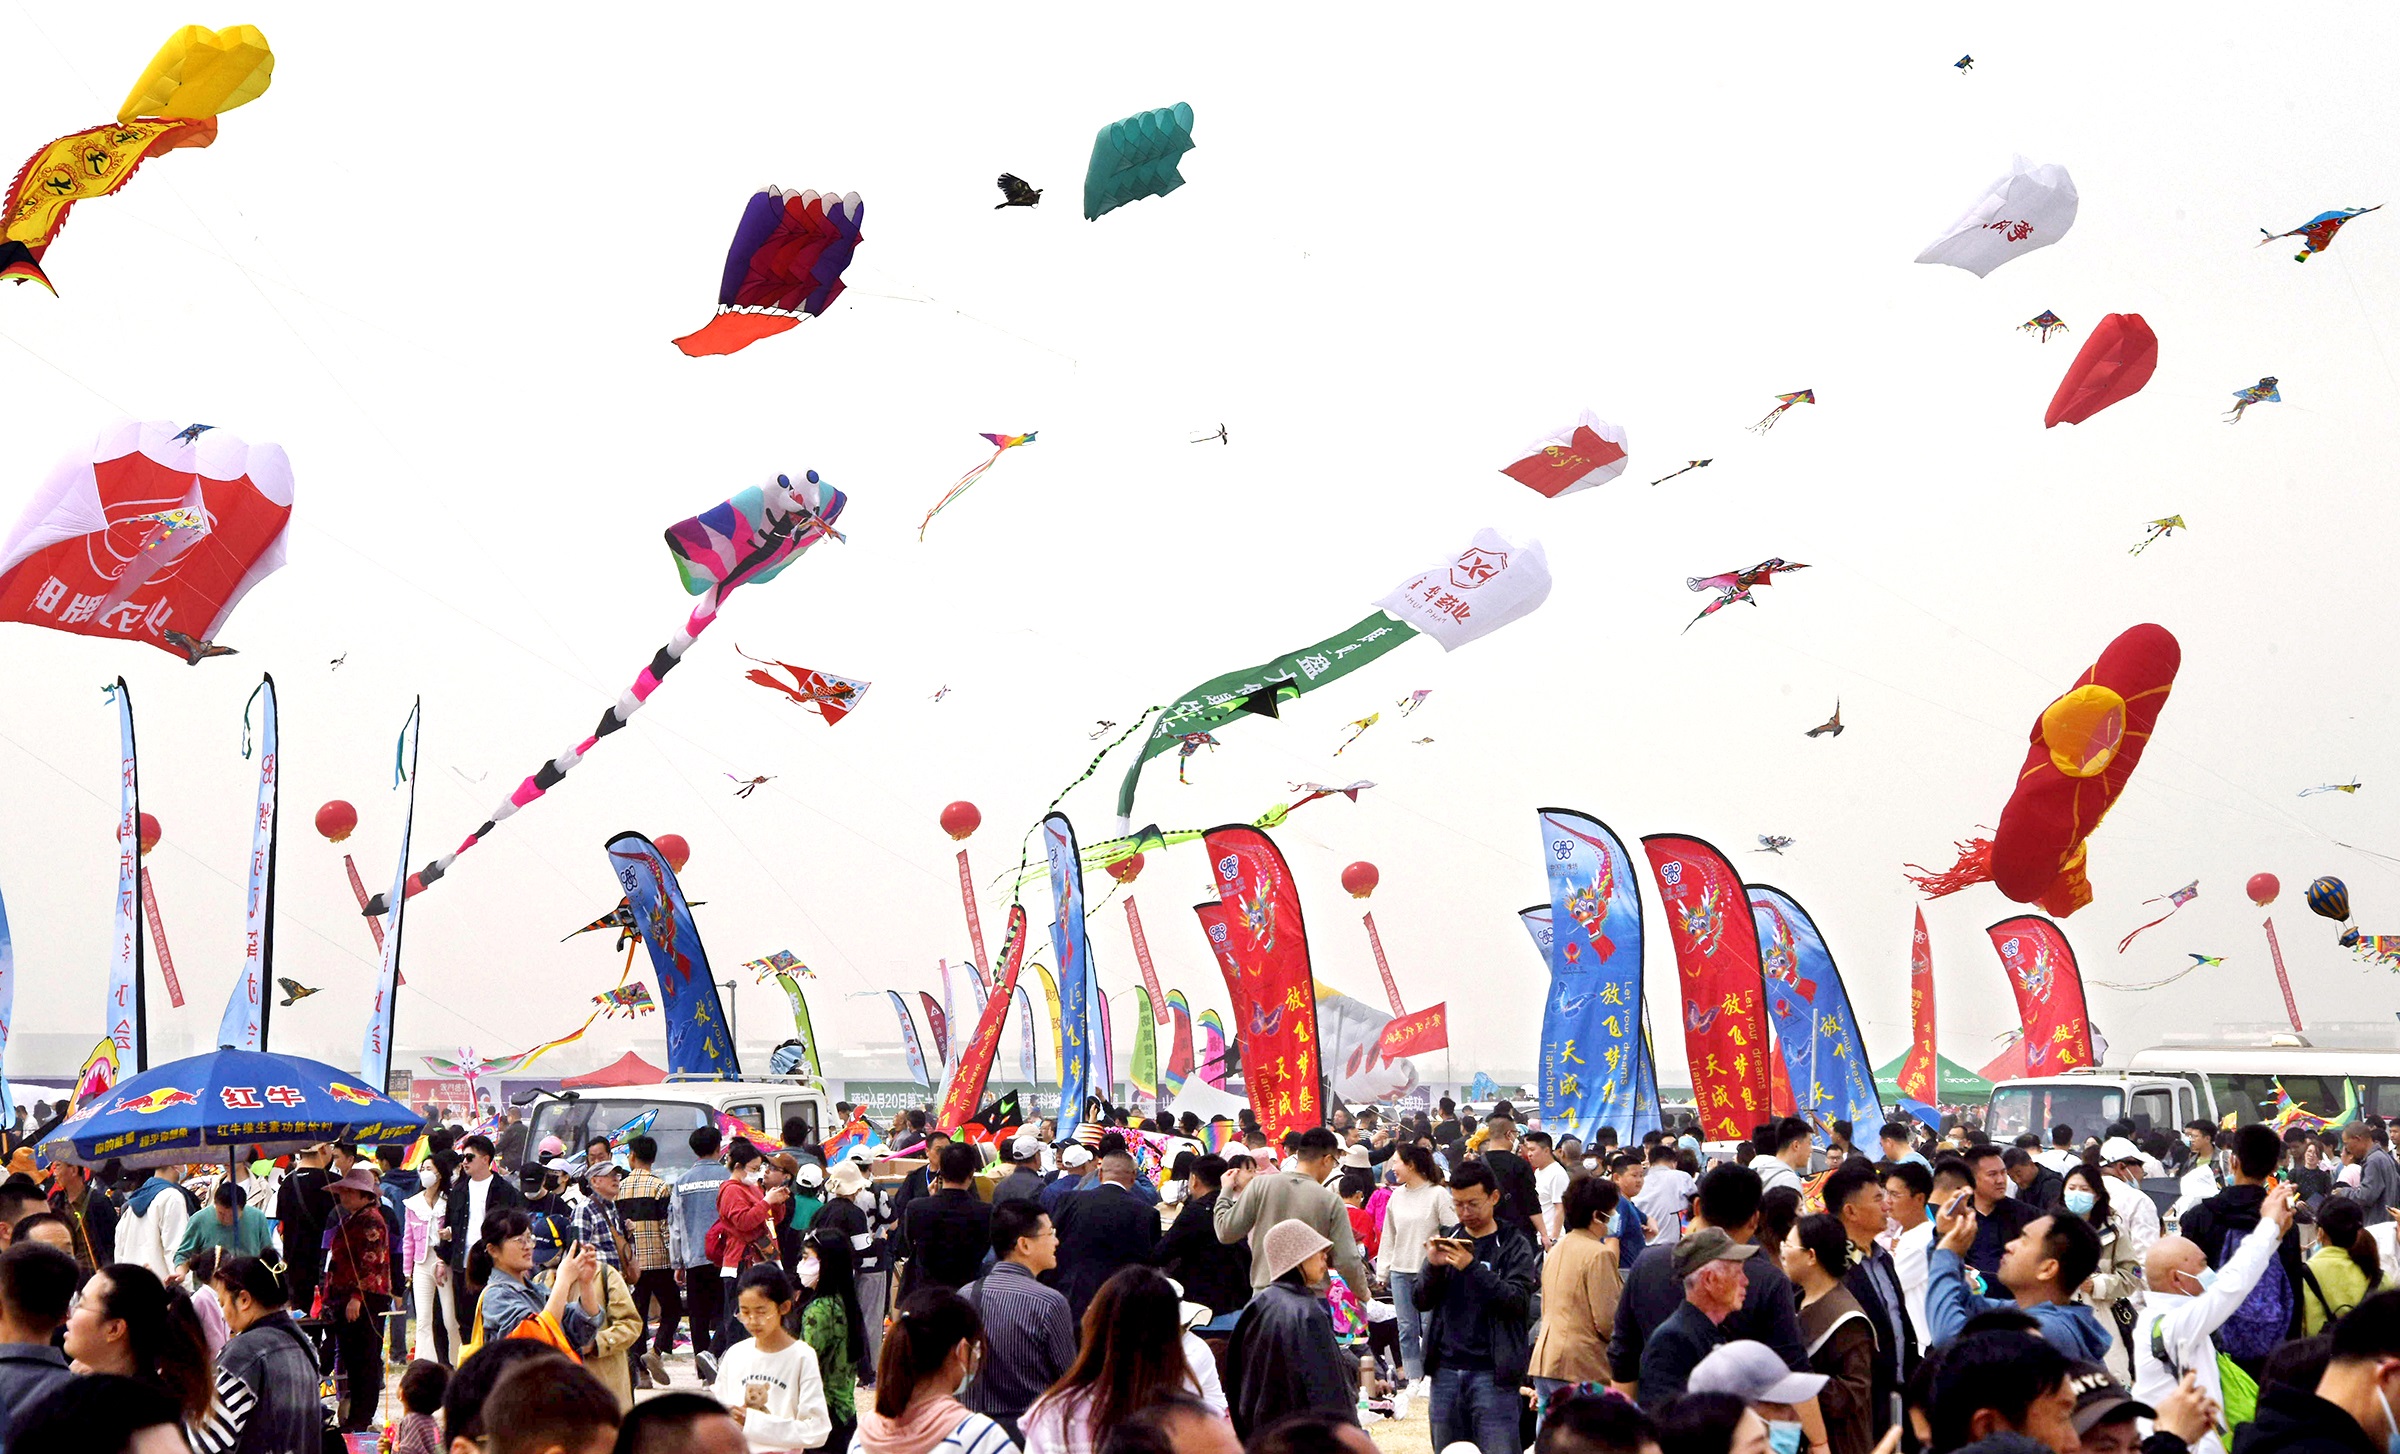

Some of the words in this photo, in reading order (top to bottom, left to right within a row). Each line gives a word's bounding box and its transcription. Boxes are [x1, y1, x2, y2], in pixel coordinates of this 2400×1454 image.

[1624, 981, 1633, 1001] Let
[1744, 989, 1754, 1008] Let
[1624, 1007, 1632, 1034] your
[1746, 1016, 1758, 1041] your
[2051, 1023, 2077, 1064] 放飞
[1545, 1042, 1558, 1108] Tiancheng
[1753, 1048, 1766, 1090] dreams
[219, 1085, 306, 1110] 红牛
[1256, 1064, 1277, 1130] Tiancheng
[1690, 1059, 1711, 1121] Tiancheng
[217, 1121, 334, 1137] 红牛维生素功能饮料
[2068, 1372, 2109, 1395] NYC
